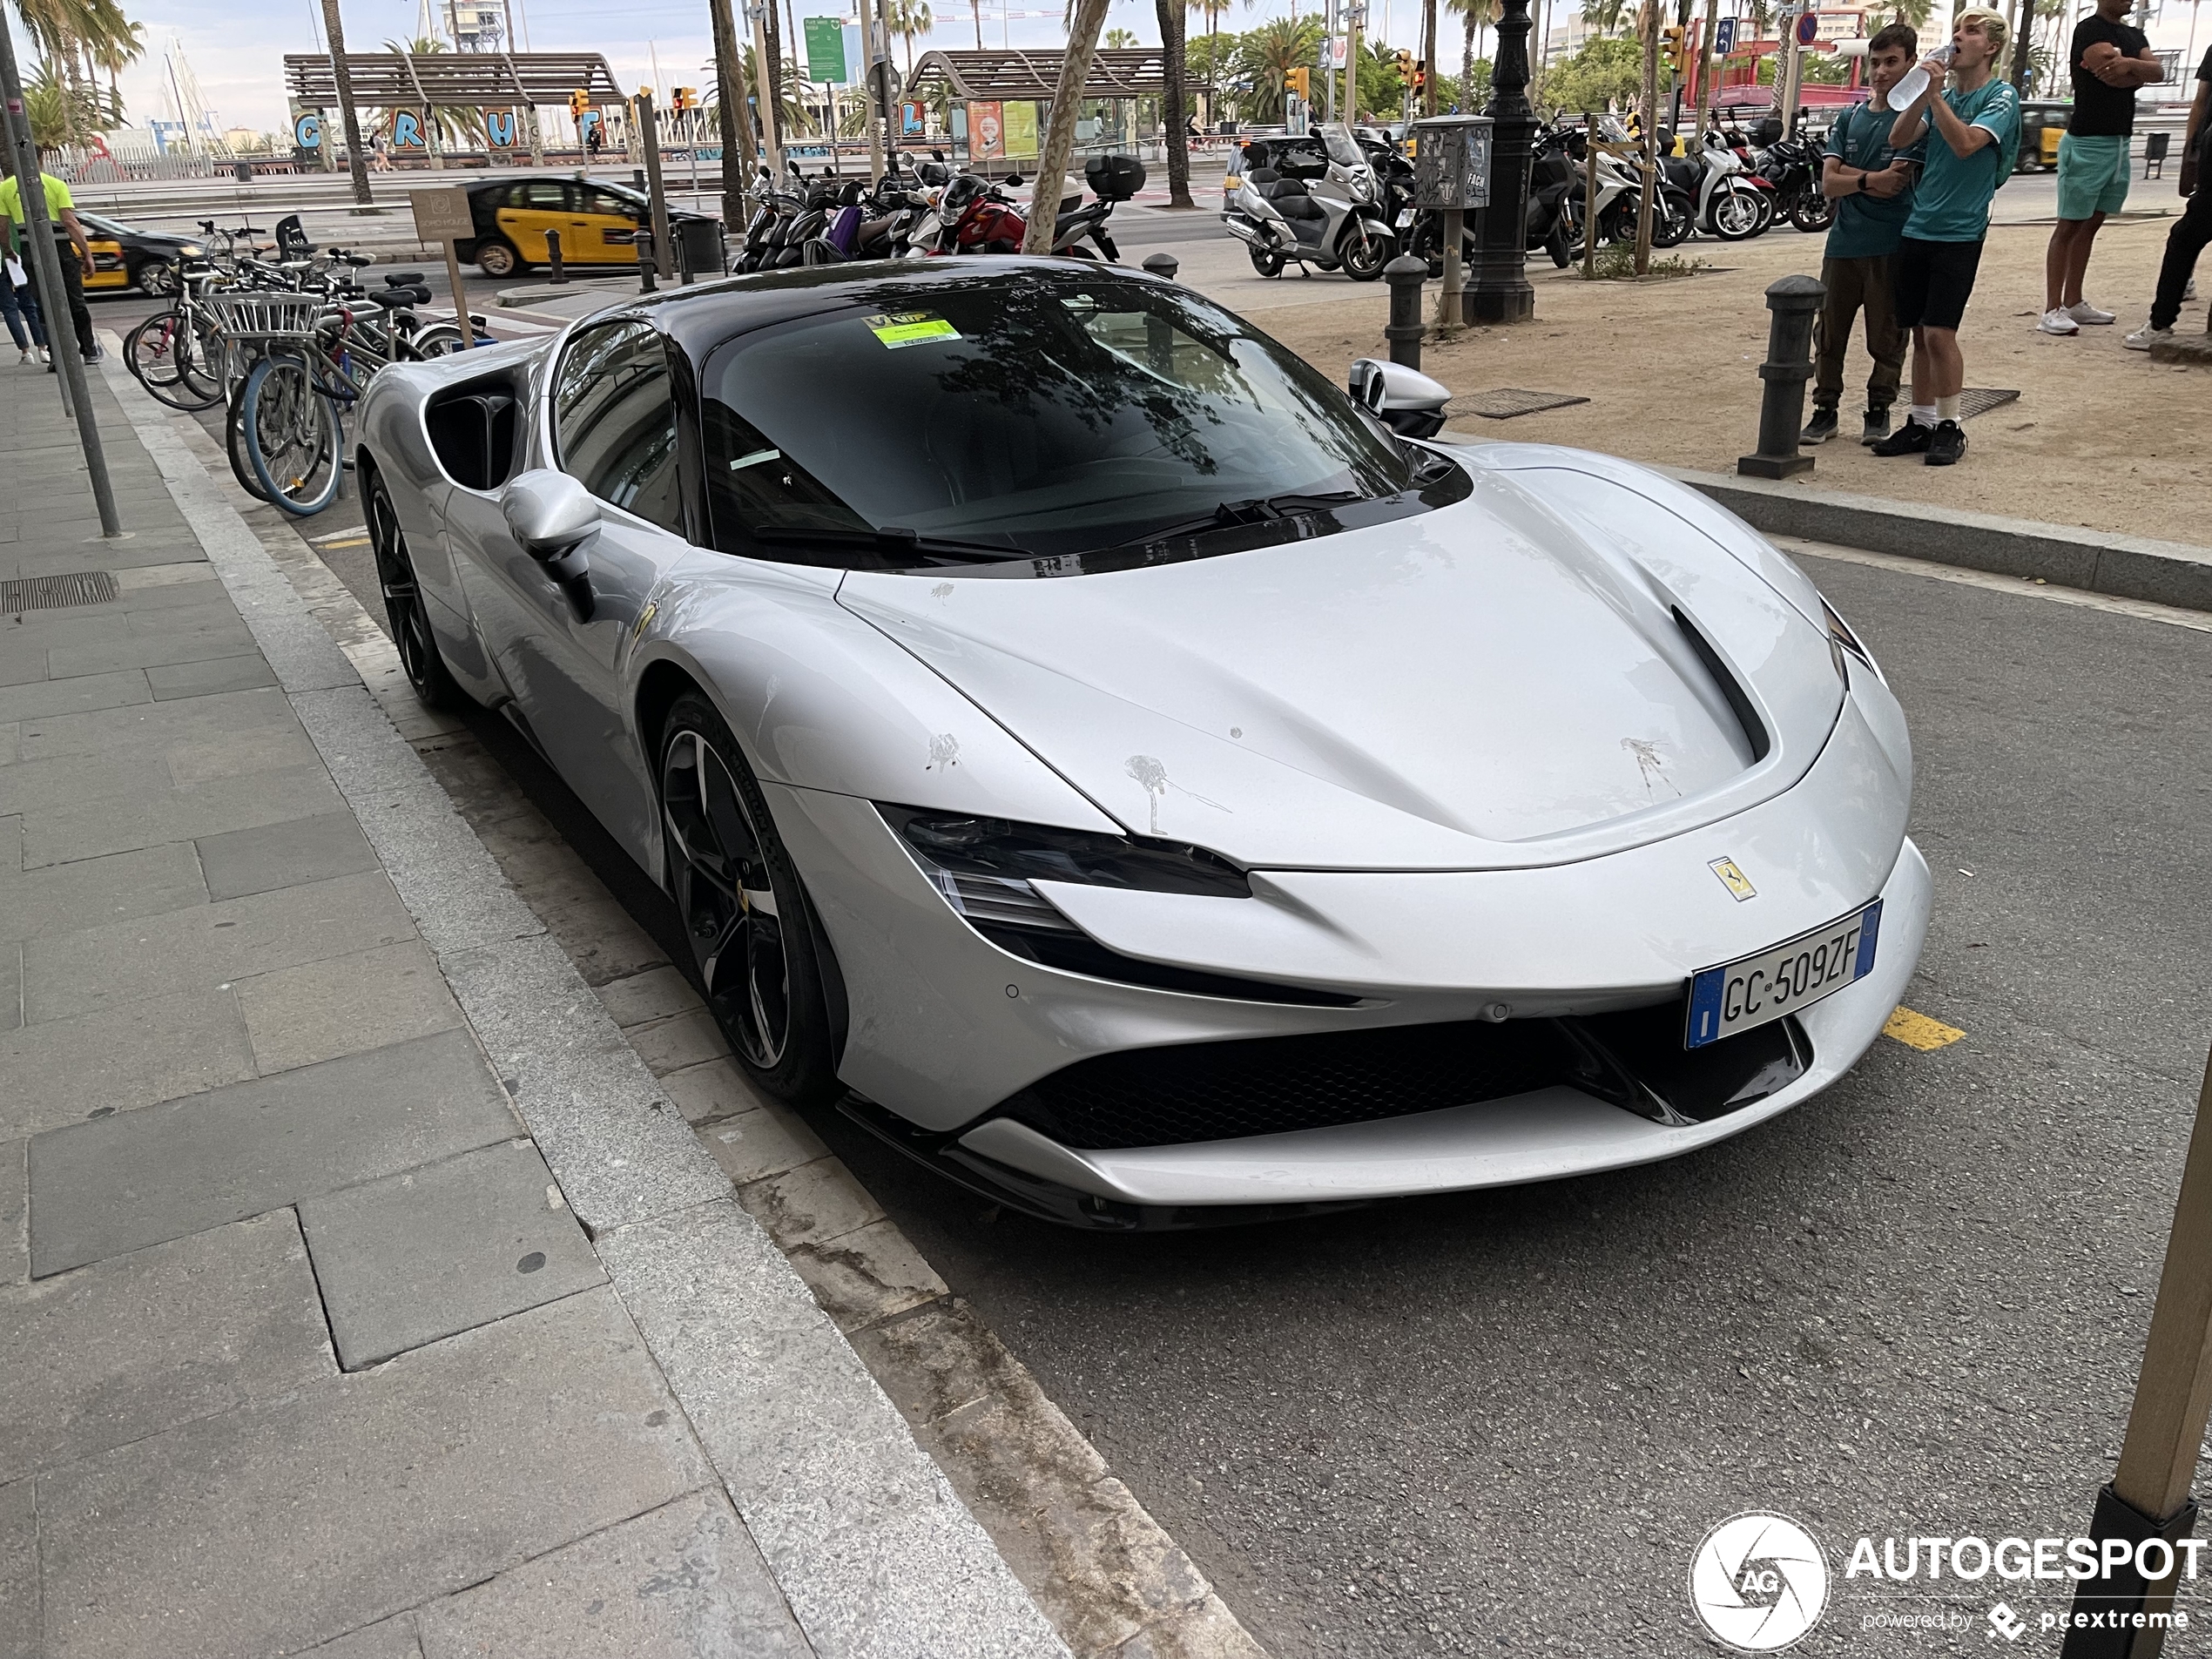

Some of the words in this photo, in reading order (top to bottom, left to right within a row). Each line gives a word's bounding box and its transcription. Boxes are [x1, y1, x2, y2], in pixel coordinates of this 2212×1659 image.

[394, 110, 427, 147] R
[901, 102, 923, 136] L
[1467, 173, 1486, 188] FACH
[729, 752, 768, 833] MICHELIN
